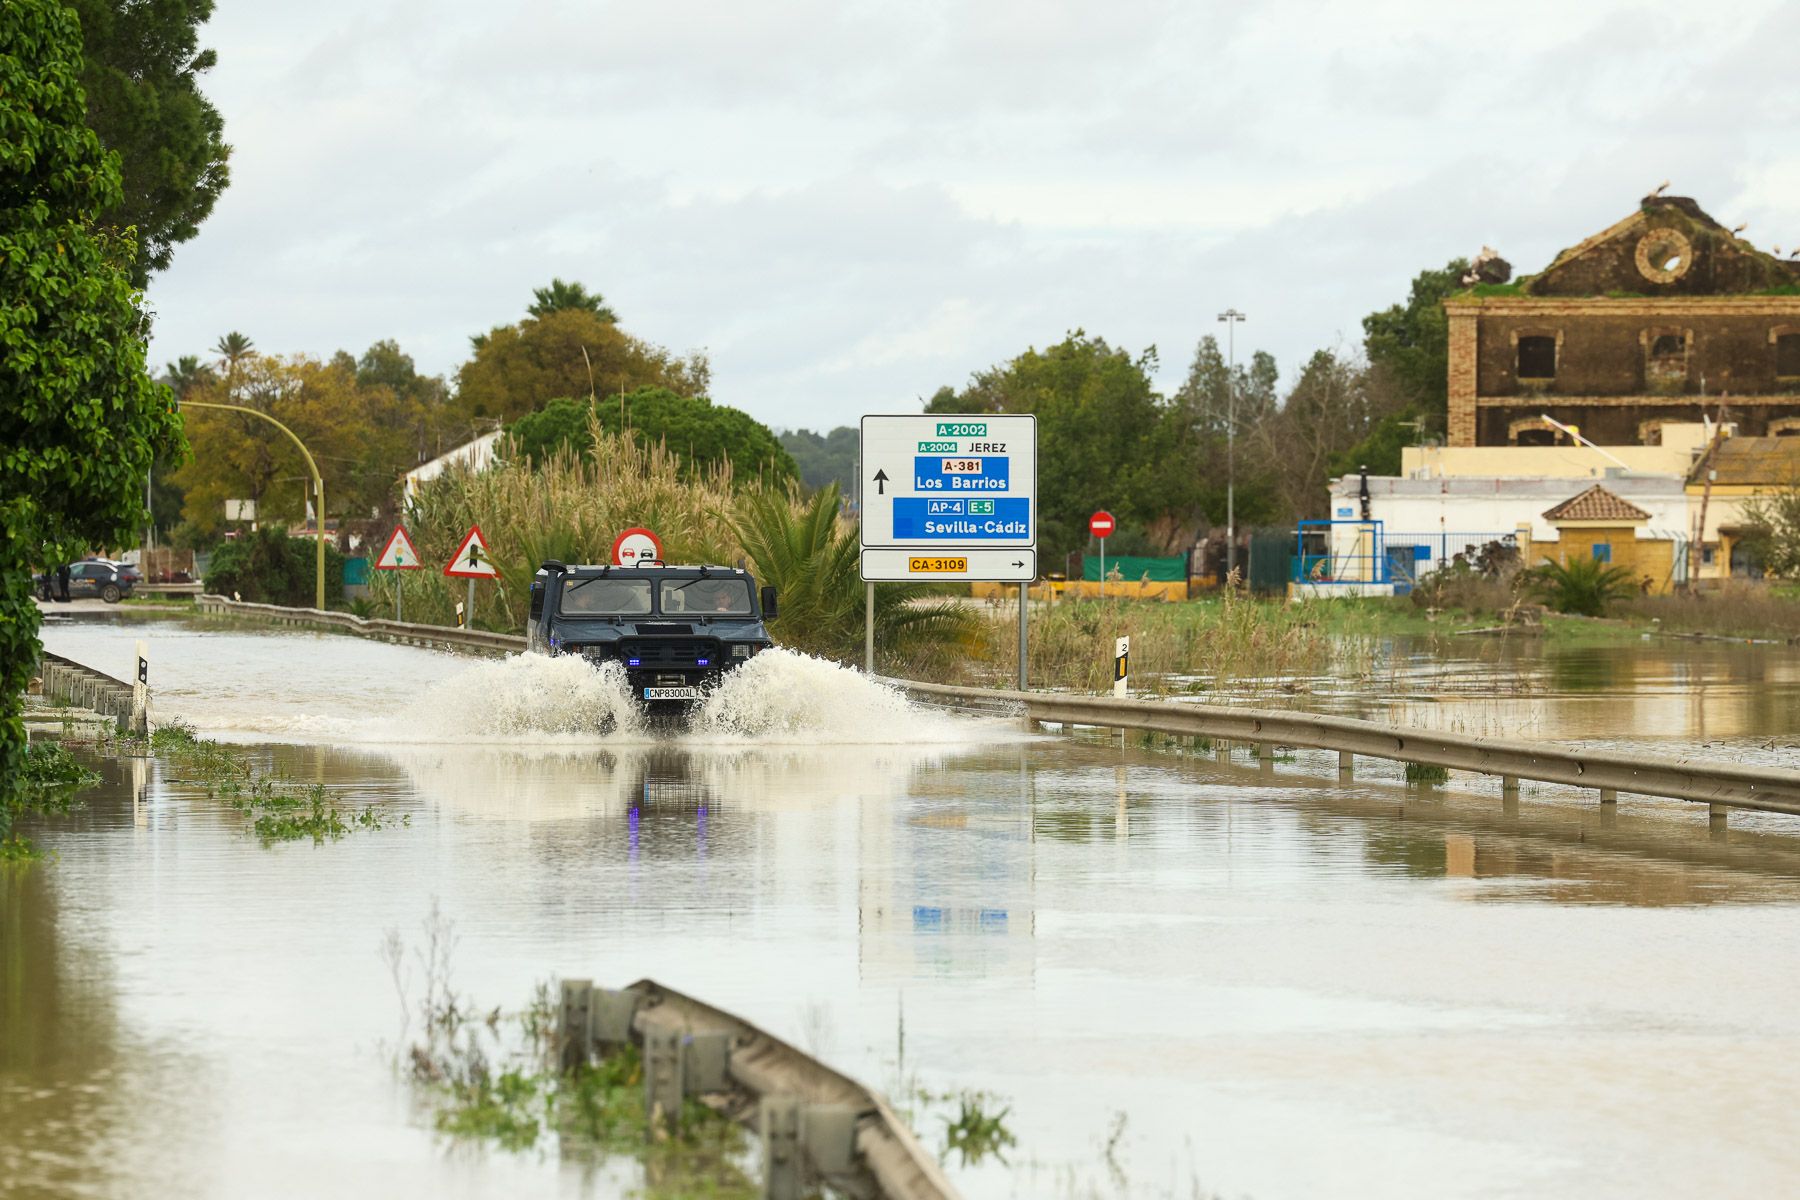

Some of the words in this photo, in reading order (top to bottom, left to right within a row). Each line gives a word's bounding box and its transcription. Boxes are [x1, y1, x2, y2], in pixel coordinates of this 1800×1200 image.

[938, 425, 986, 435] A-2002
[919, 443, 956, 452] A-2004
[969, 443, 1006, 453] JEREZ
[944, 461, 980, 471] A-381
[917, 476, 942, 488] Los
[952, 476, 1006, 488] Barrios
[930, 502, 962, 512] AP-4
[970, 502, 992, 512] E-5
[925, 520, 1027, 533] Sevilla-Cádiz
[912, 559, 965, 570] CA-3109
